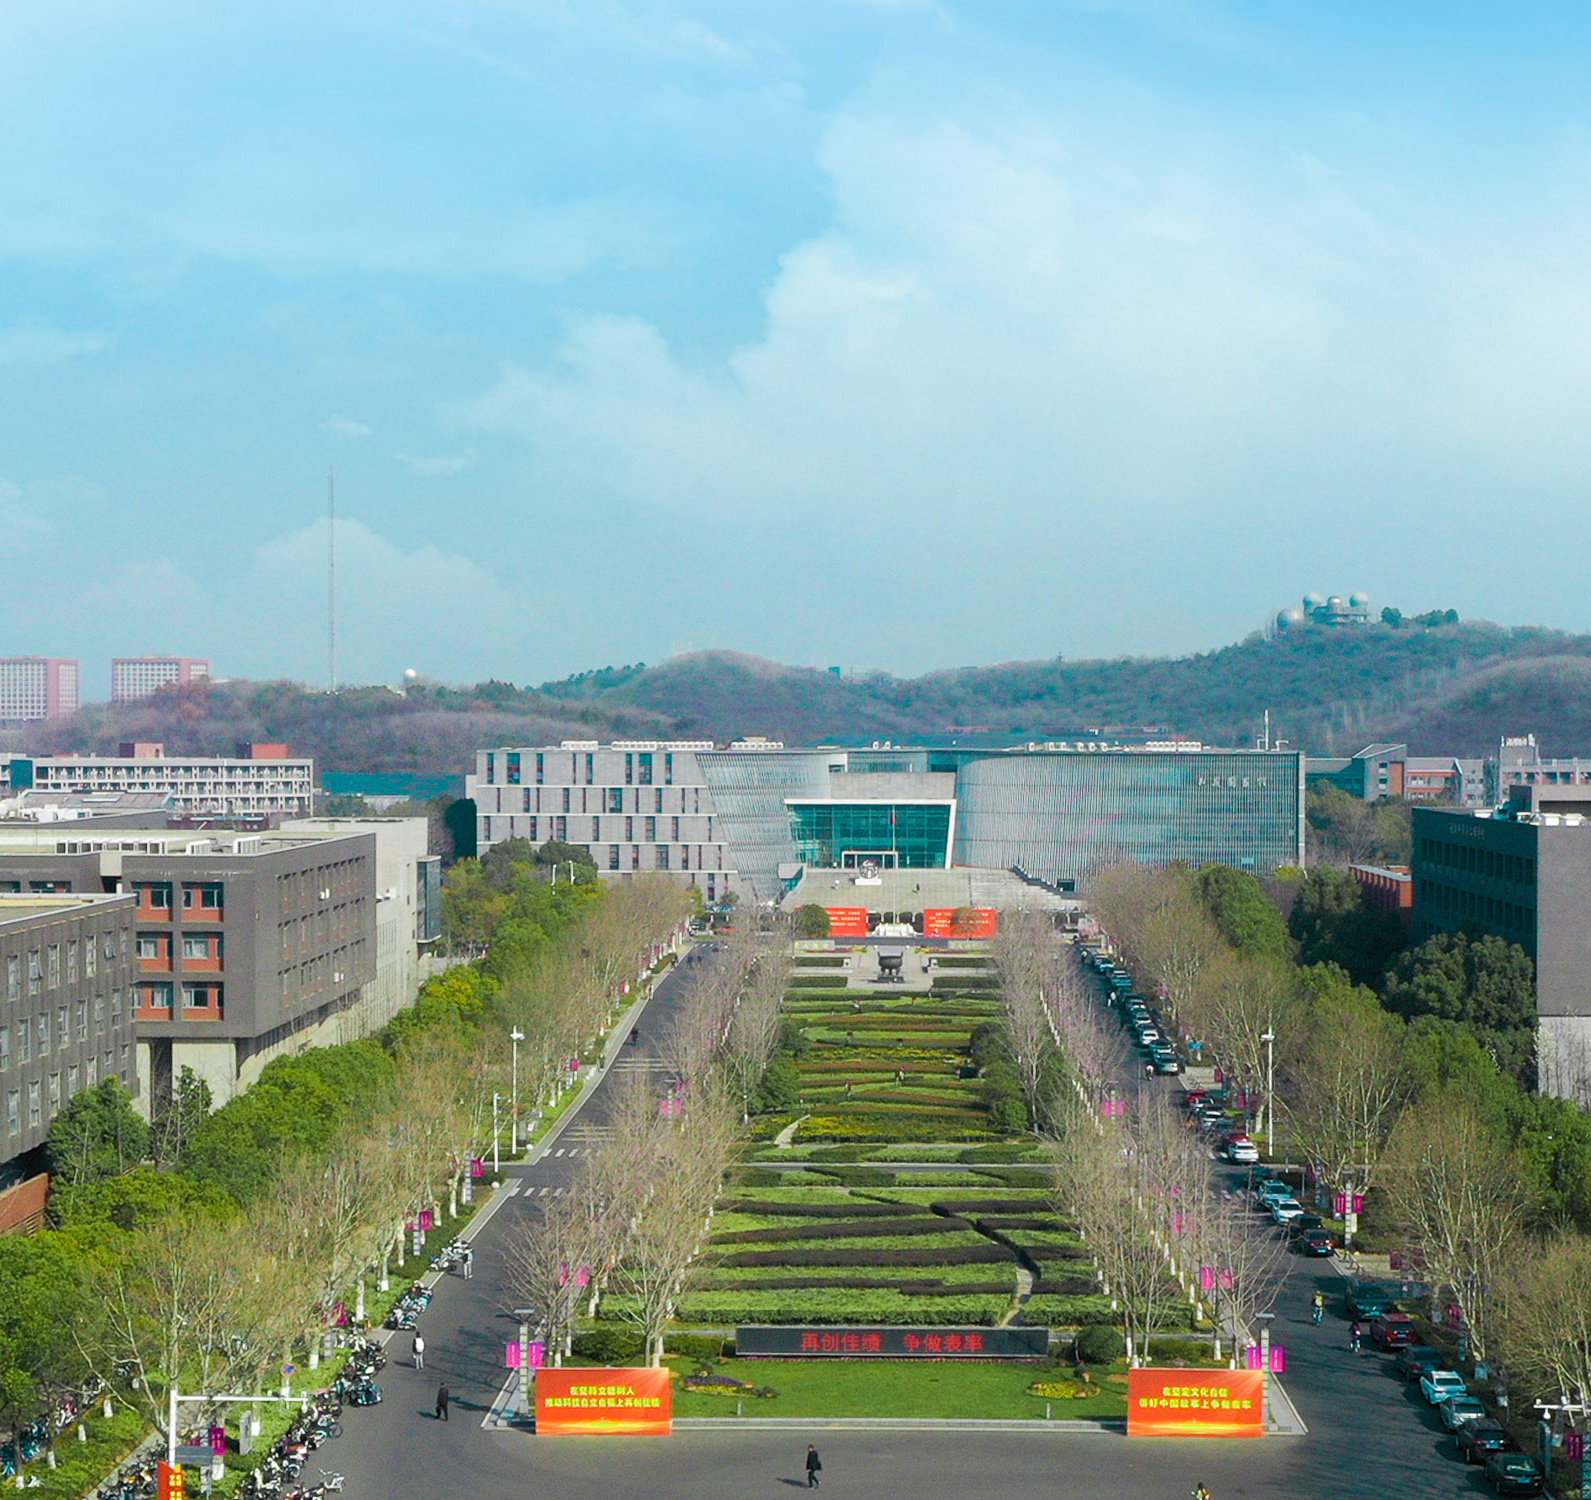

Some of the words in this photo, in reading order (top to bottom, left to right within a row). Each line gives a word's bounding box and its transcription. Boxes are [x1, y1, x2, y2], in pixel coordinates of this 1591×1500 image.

[800, 1332, 881, 1352] 再创佳绩
[903, 1333, 985, 1353] 争做表率
